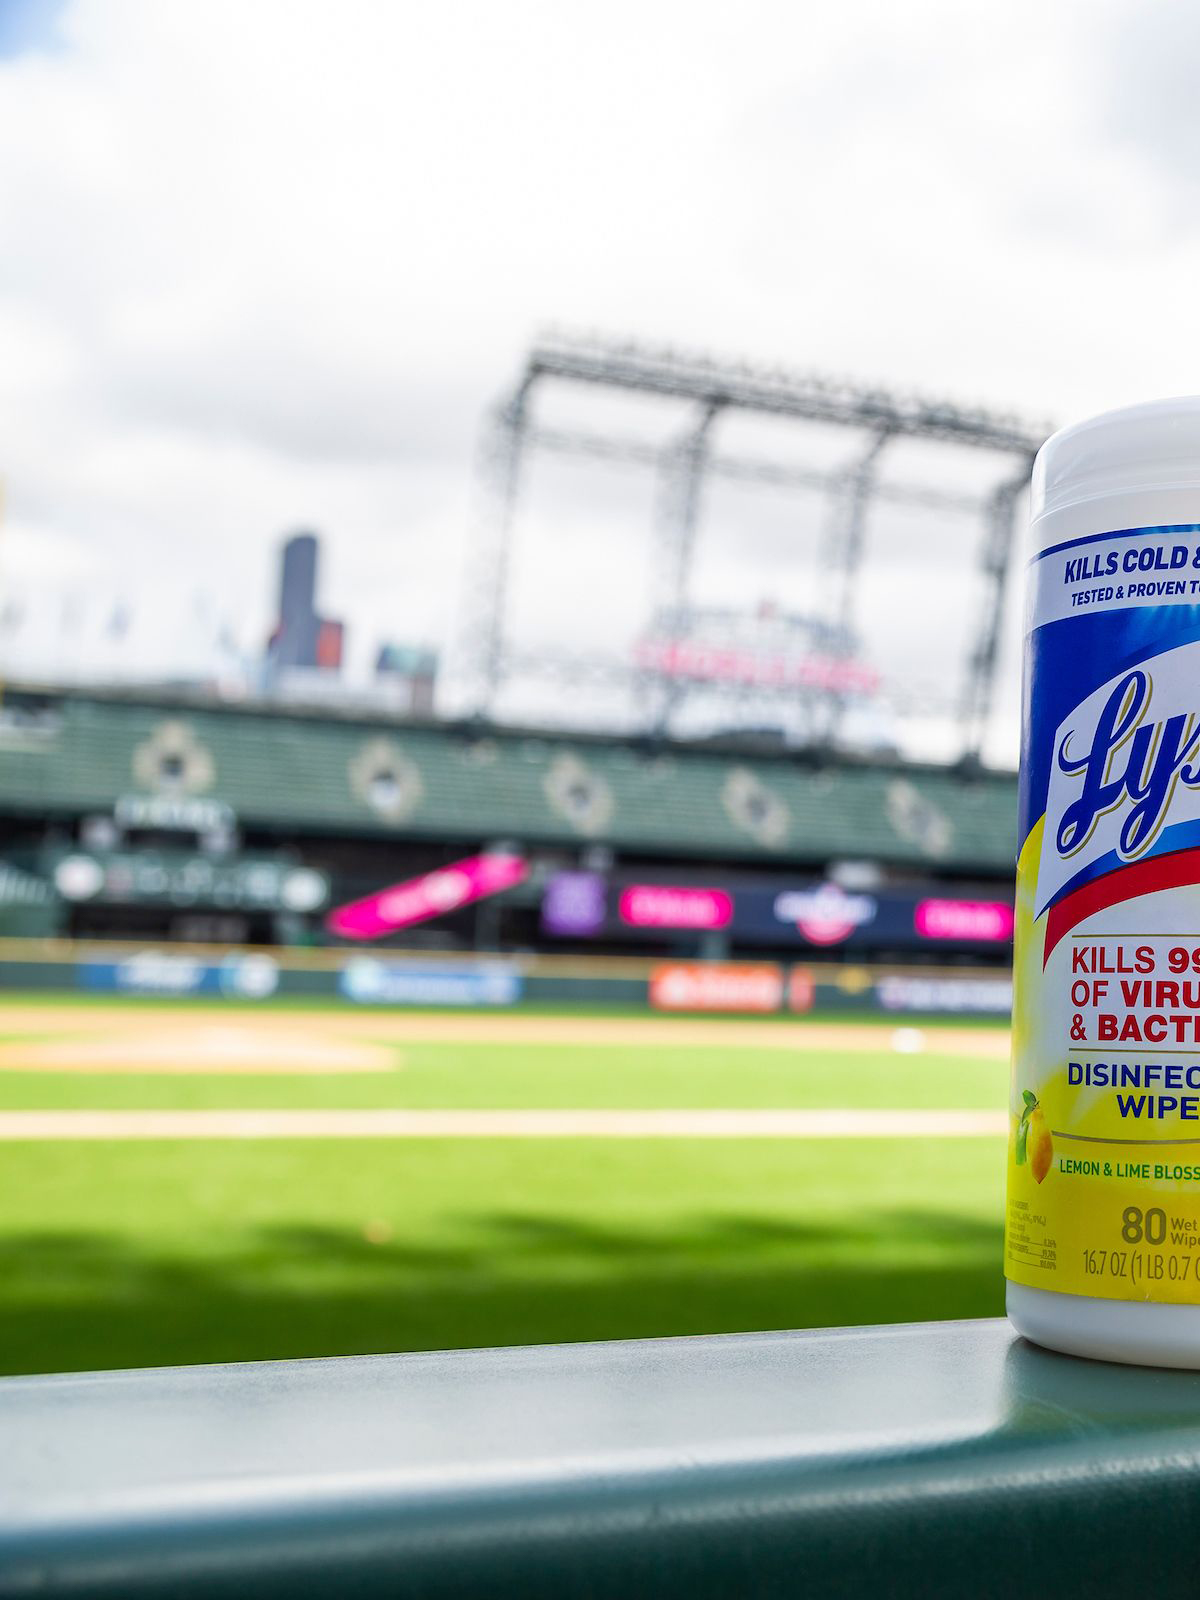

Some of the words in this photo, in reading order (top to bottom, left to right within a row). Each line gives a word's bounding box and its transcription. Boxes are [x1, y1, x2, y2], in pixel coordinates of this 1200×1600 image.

[1064, 552, 1119, 584] KILLS
[1122, 546, 1189, 573] COLD
[1071, 587, 1114, 607] TESTED
[1115, 585, 1124, 600] &
[1127, 581, 1187, 598] PROVEN
[1072, 946, 1155, 974] KILLS
[1071, 980, 1109, 1007] OF
[1070, 1013, 1087, 1041] &
[1060, 1159, 1100, 1176] LEMON
[1103, 1162, 1112, 1177] &
[1116, 1164, 1150, 1178] LIME
[1121, 1206, 1167, 1245] 80
[1170, 1217, 1198, 1232] Wet
[1083, 1250, 1107, 1275] 16.7
[1110, 1251, 1127, 1277] OZ
[1131, 1250, 1143, 1286] (1
[1147, 1255, 1164, 1280] LB
[1168, 1256, 1191, 1281] 0.7
